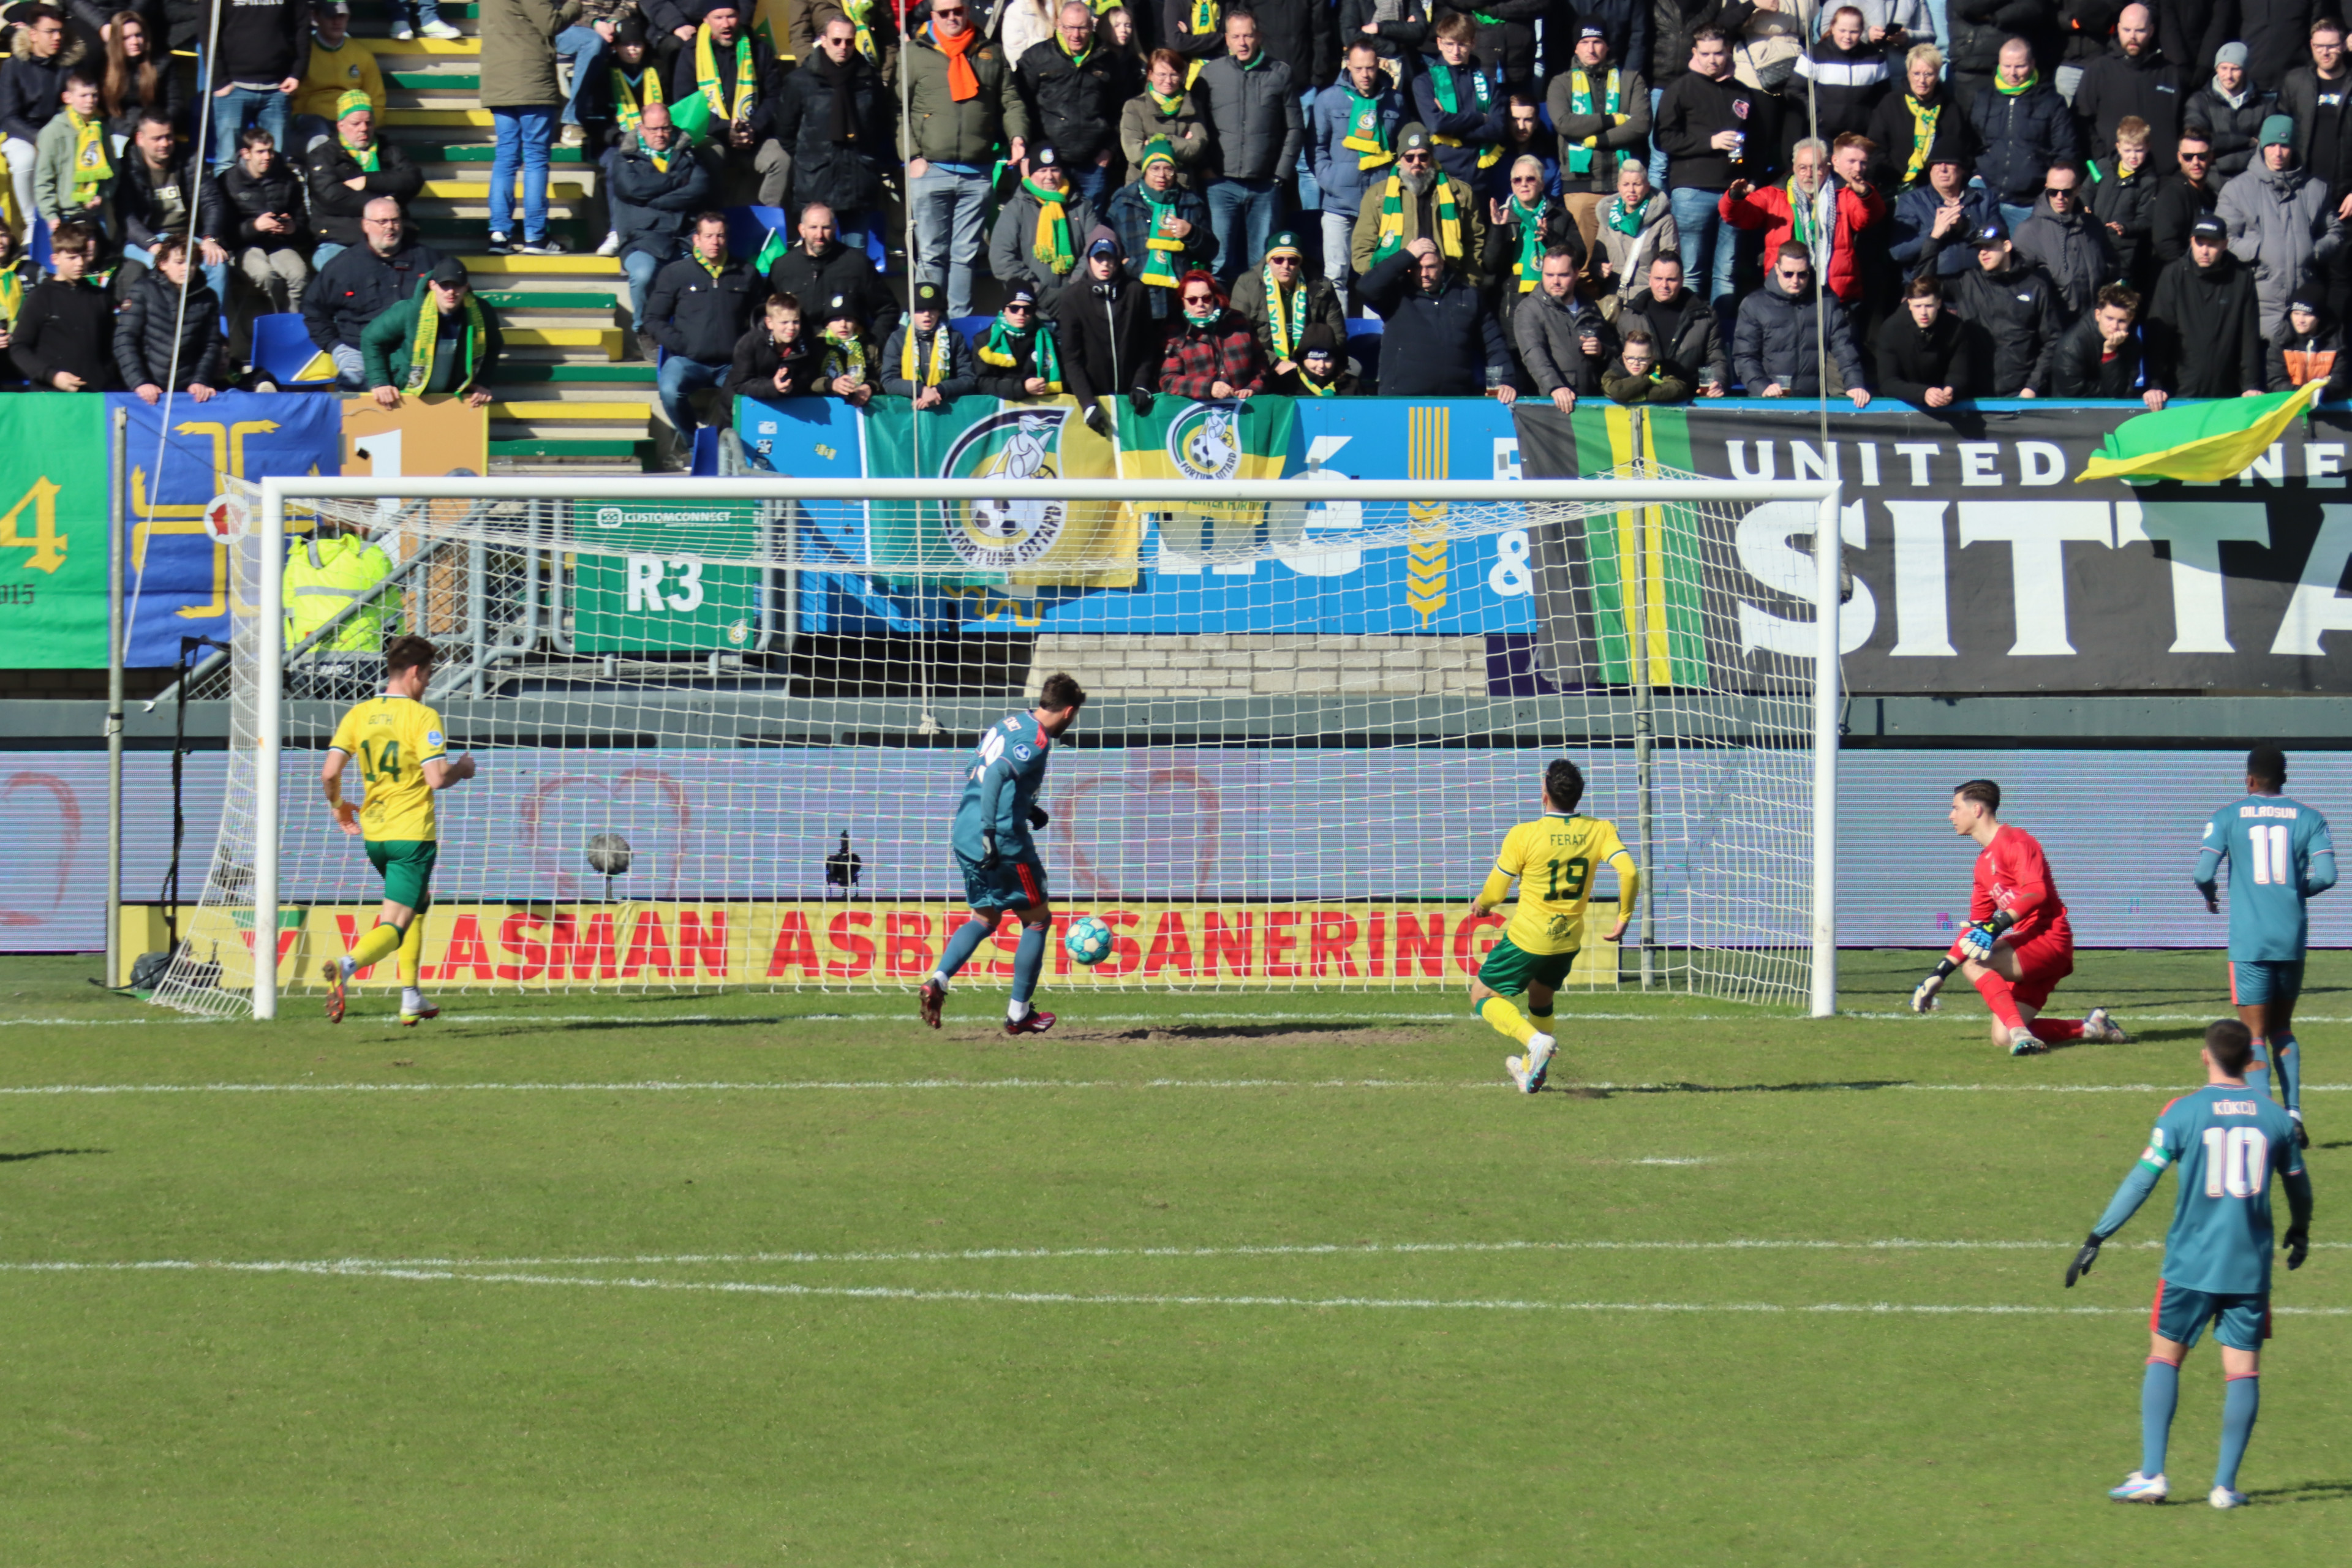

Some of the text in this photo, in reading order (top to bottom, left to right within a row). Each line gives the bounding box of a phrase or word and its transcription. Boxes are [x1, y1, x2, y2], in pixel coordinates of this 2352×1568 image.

[1725, 440, 2066, 486] UNITED
[625, 511, 731, 522] CUSTOMCONNECT
[951, 506, 1061, 566] FORTUNA SITTARD
[628, 552, 704, 612] R3
[361, 740, 402, 783] 14
[2239, 806, 2297, 820] DILROSUN
[1550, 834, 1586, 846] FERATI
[2249, 825, 2288, 884] 11
[1544, 858, 1589, 901] 19
[766, 910, 1509, 978] ASBESTSANERING
[2203, 1126, 2267, 1198] 10
